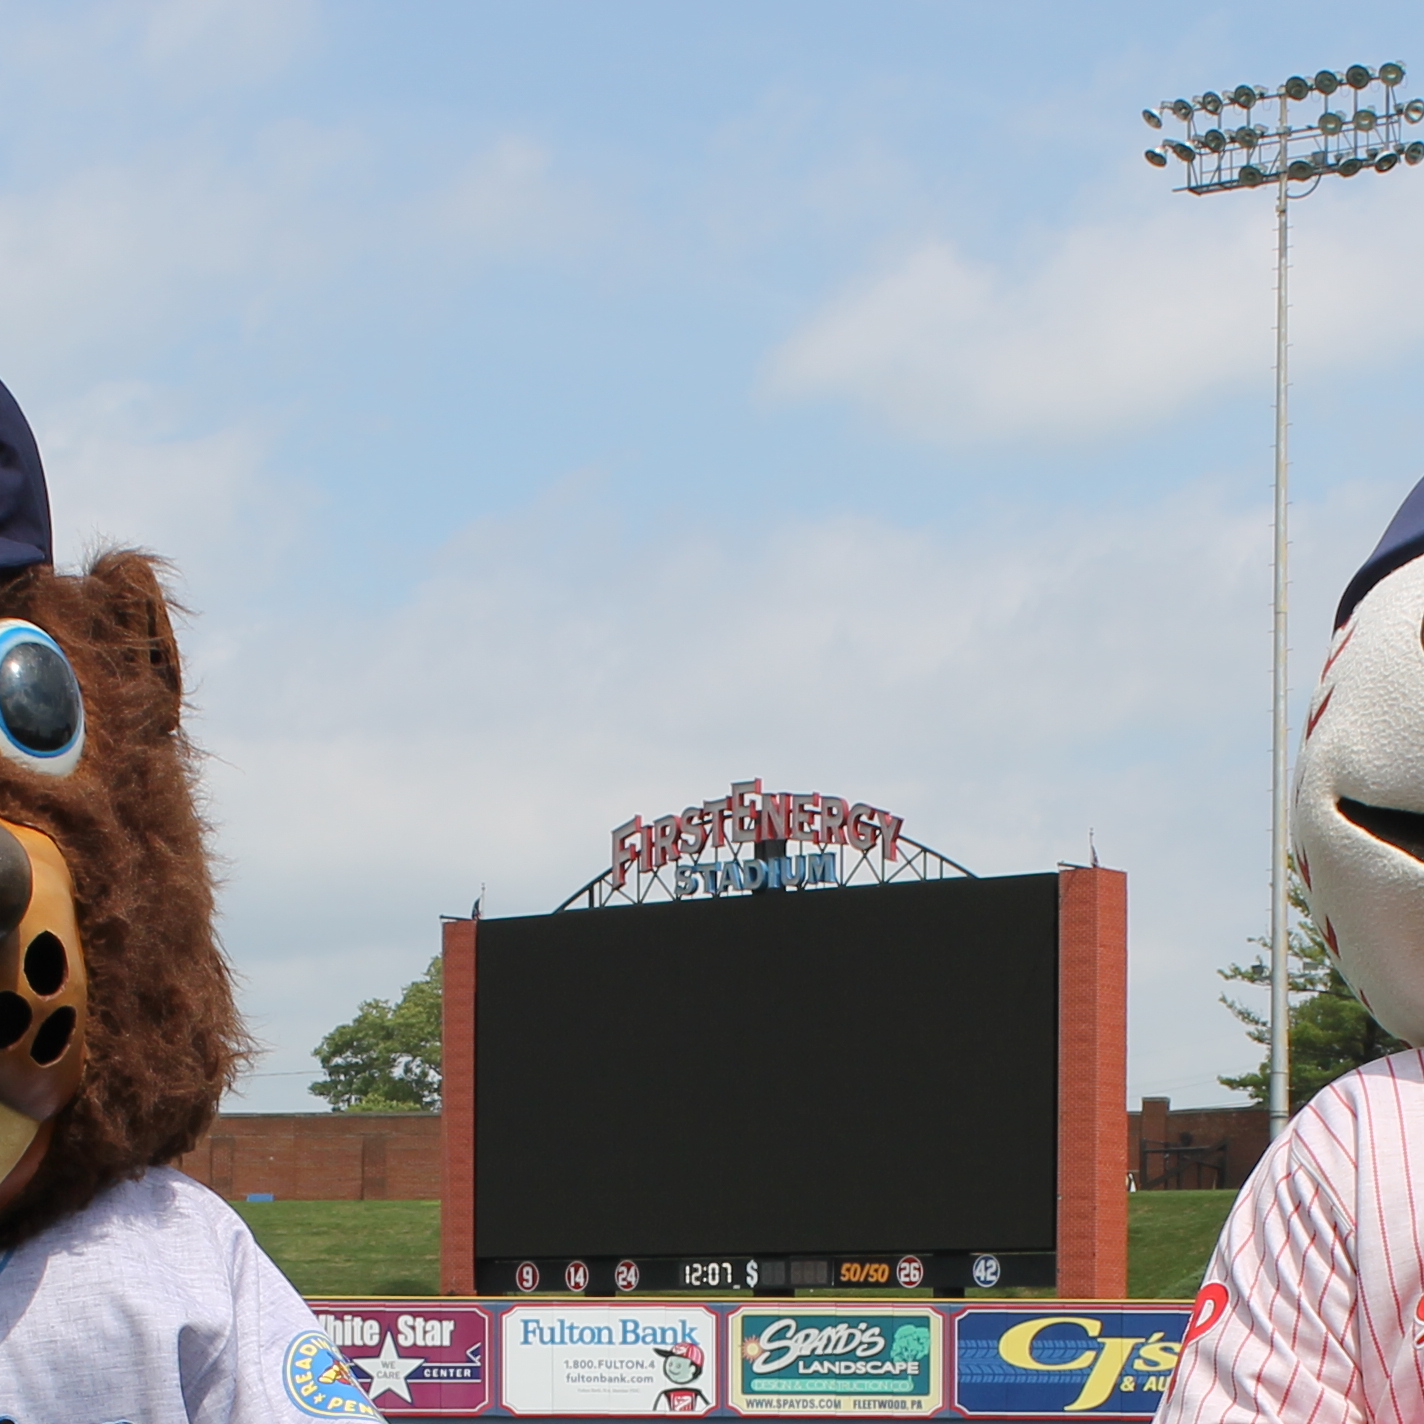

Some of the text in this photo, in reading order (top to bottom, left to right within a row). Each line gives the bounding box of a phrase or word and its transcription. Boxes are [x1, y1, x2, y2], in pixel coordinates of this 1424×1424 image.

[676, 851, 838, 896] STADIUM
[522, 1266, 533, 1287] 9
[569, 1266, 585, 1286] 14
[617, 1265, 637, 1285] 24
[685, 1262, 732, 1286] 12:07
[840, 1262, 890, 1283] 50/50
[899, 1263, 921, 1282] 26
[975, 1260, 997, 1282] 42
[397, 1314, 456, 1347] Star
[519, 1318, 701, 1346] Fulton Bank
[380, 1361, 396, 1370] WE
[424, 1369, 472, 1378] CENTER
[563, 1359, 656, 1370] 1.800.FULTON.4
[798, 1361, 920, 1375] LANDSCAPE
[998, 1316, 1183, 1411] CJ's
[376, 1371, 401, 1380] CARE
[565, 1372, 654, 1384] fultonbank.com
[1120, 1375, 1172, 1392] & AU
[745, 1399, 841, 1409] WWW.SPAYDS.COM
[910, 1400, 923, 1409] PA
